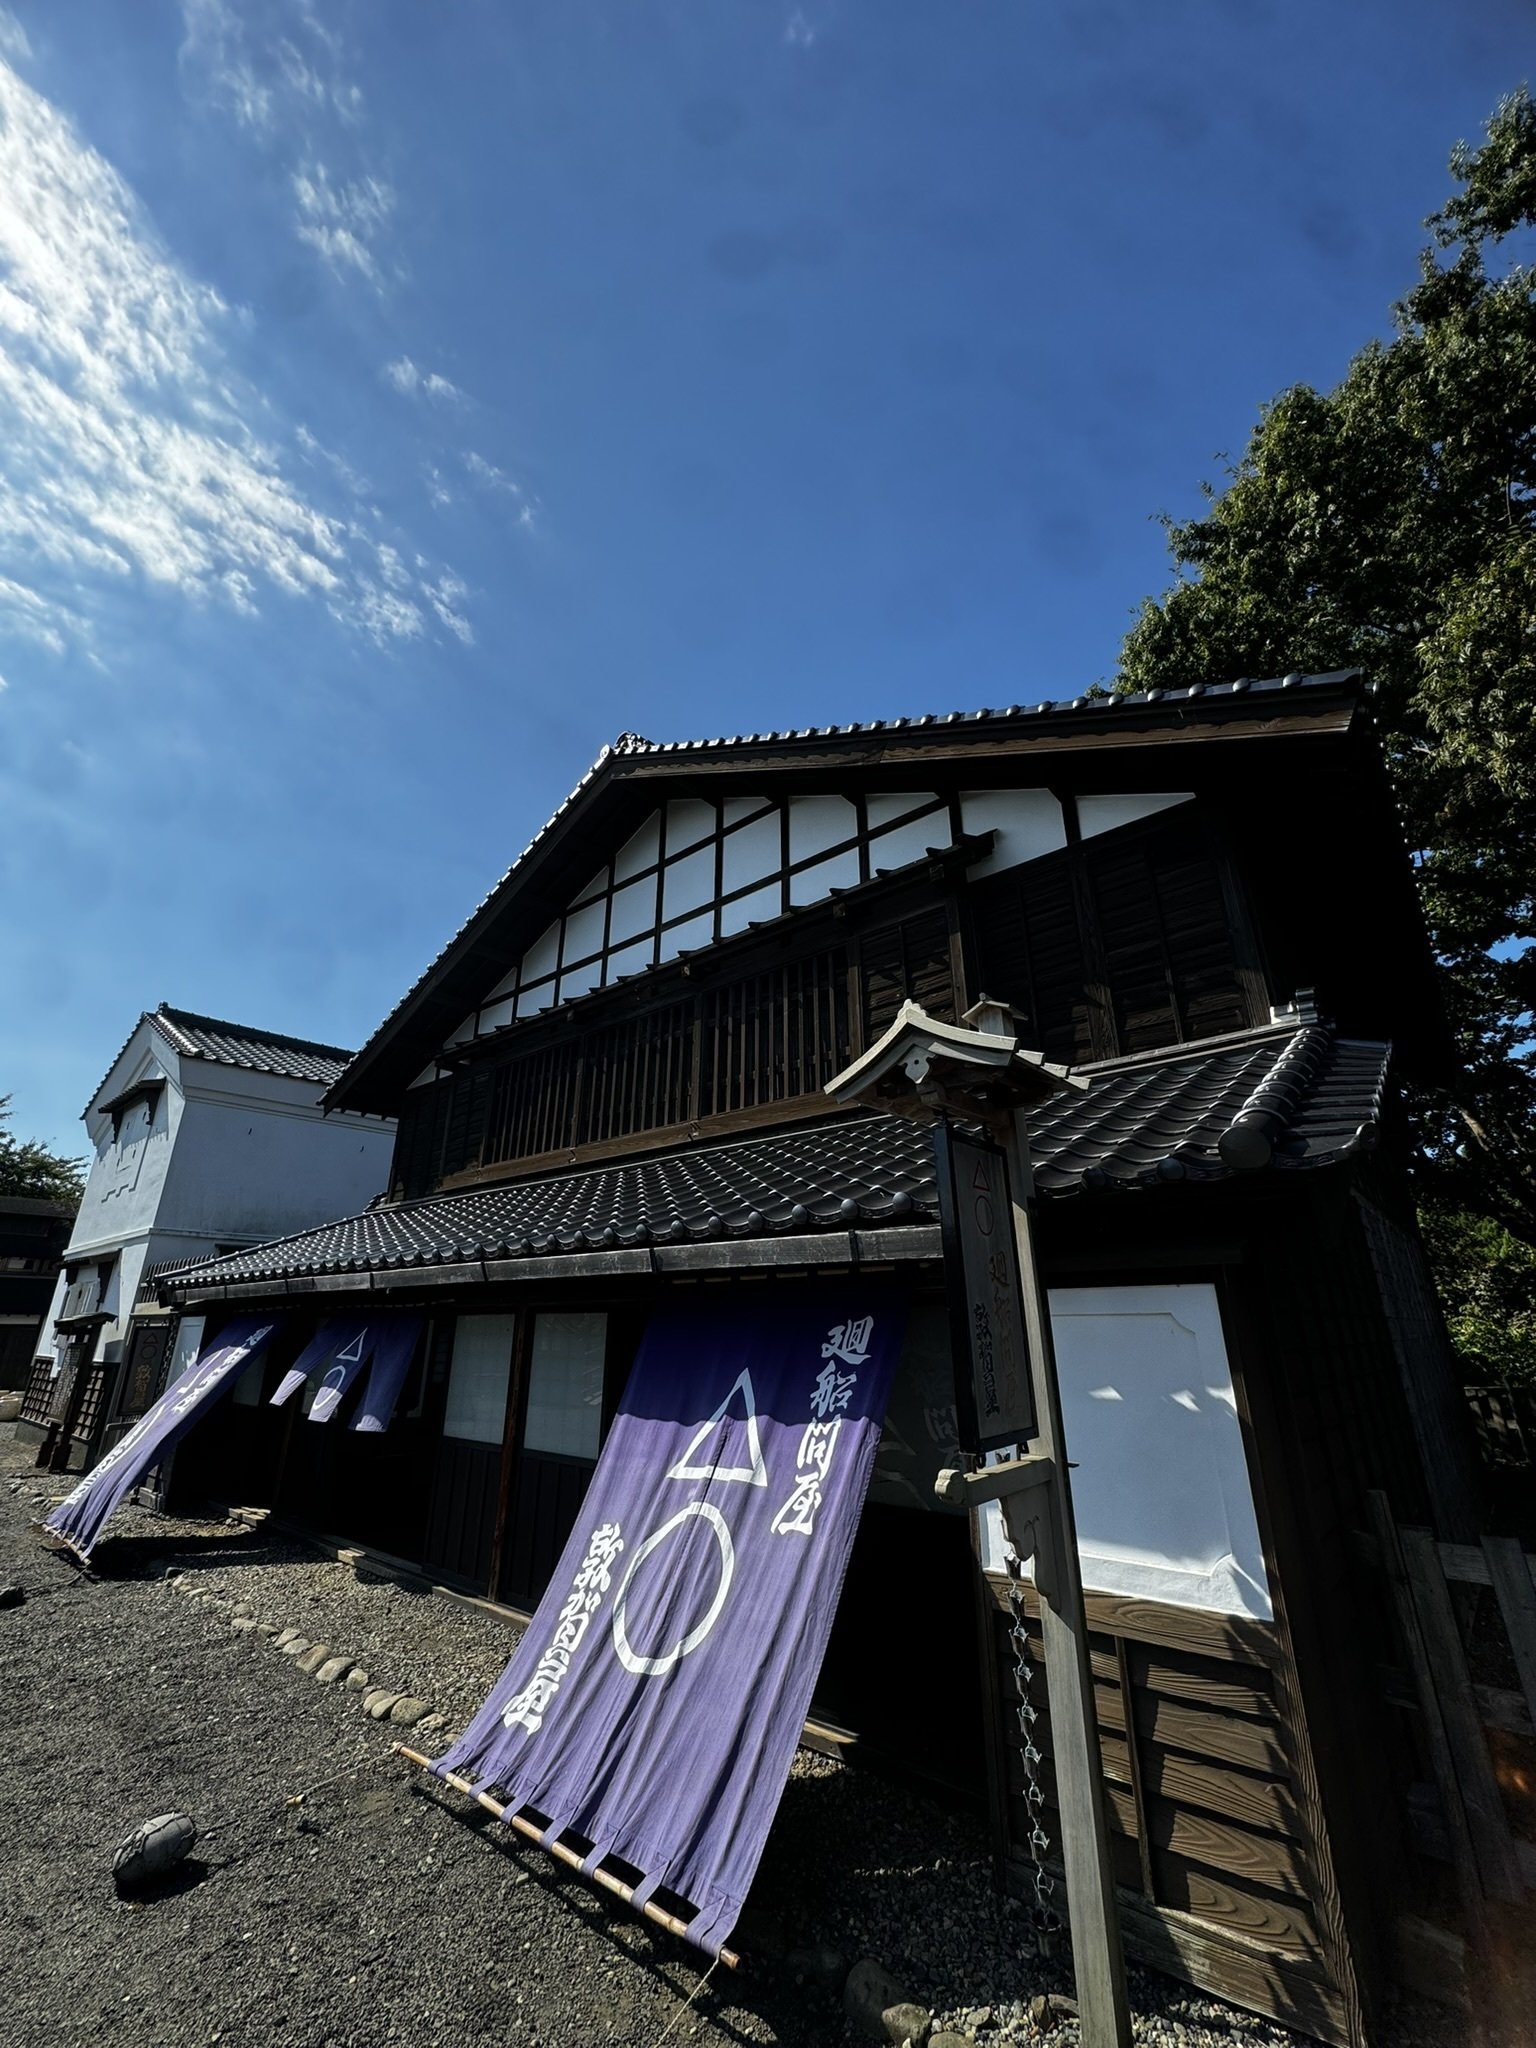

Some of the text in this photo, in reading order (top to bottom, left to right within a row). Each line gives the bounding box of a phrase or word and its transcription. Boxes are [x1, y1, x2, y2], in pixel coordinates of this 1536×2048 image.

[771, 1315, 874, 1535] 廻船問屋
[501, 1521, 625, 1736] 敦賀屋
